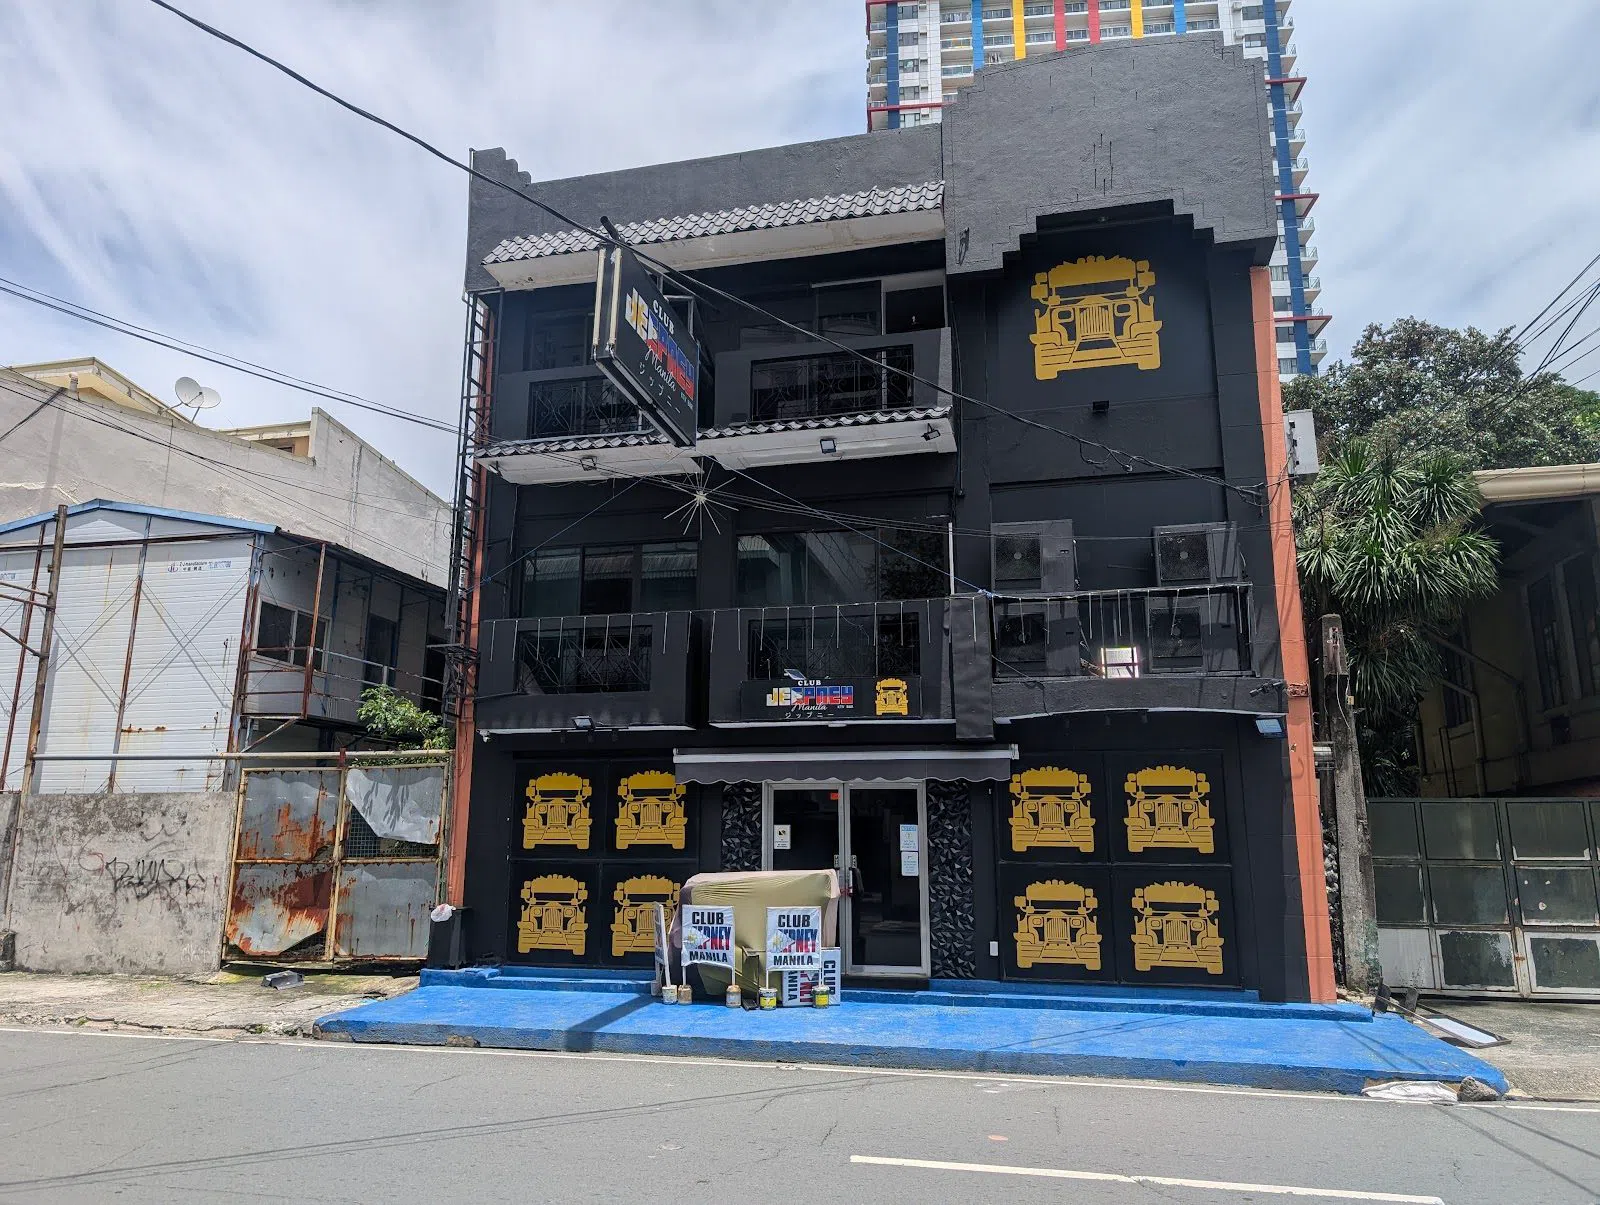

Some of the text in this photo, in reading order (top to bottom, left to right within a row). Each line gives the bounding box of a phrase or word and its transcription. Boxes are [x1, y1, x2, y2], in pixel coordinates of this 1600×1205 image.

[653, 300, 675, 335] CLUB
[644, 345, 677, 392] Manila
[766, 686, 853, 706] JEEPNEY
[791, 701, 828, 712] Manila
[691, 911, 724, 925] CLUB
[777, 914, 811, 928] CLUB
[689, 950, 728, 963] MANILA
[773, 955, 814, 966] MANILA
[788, 970, 798, 1001] ANILA
